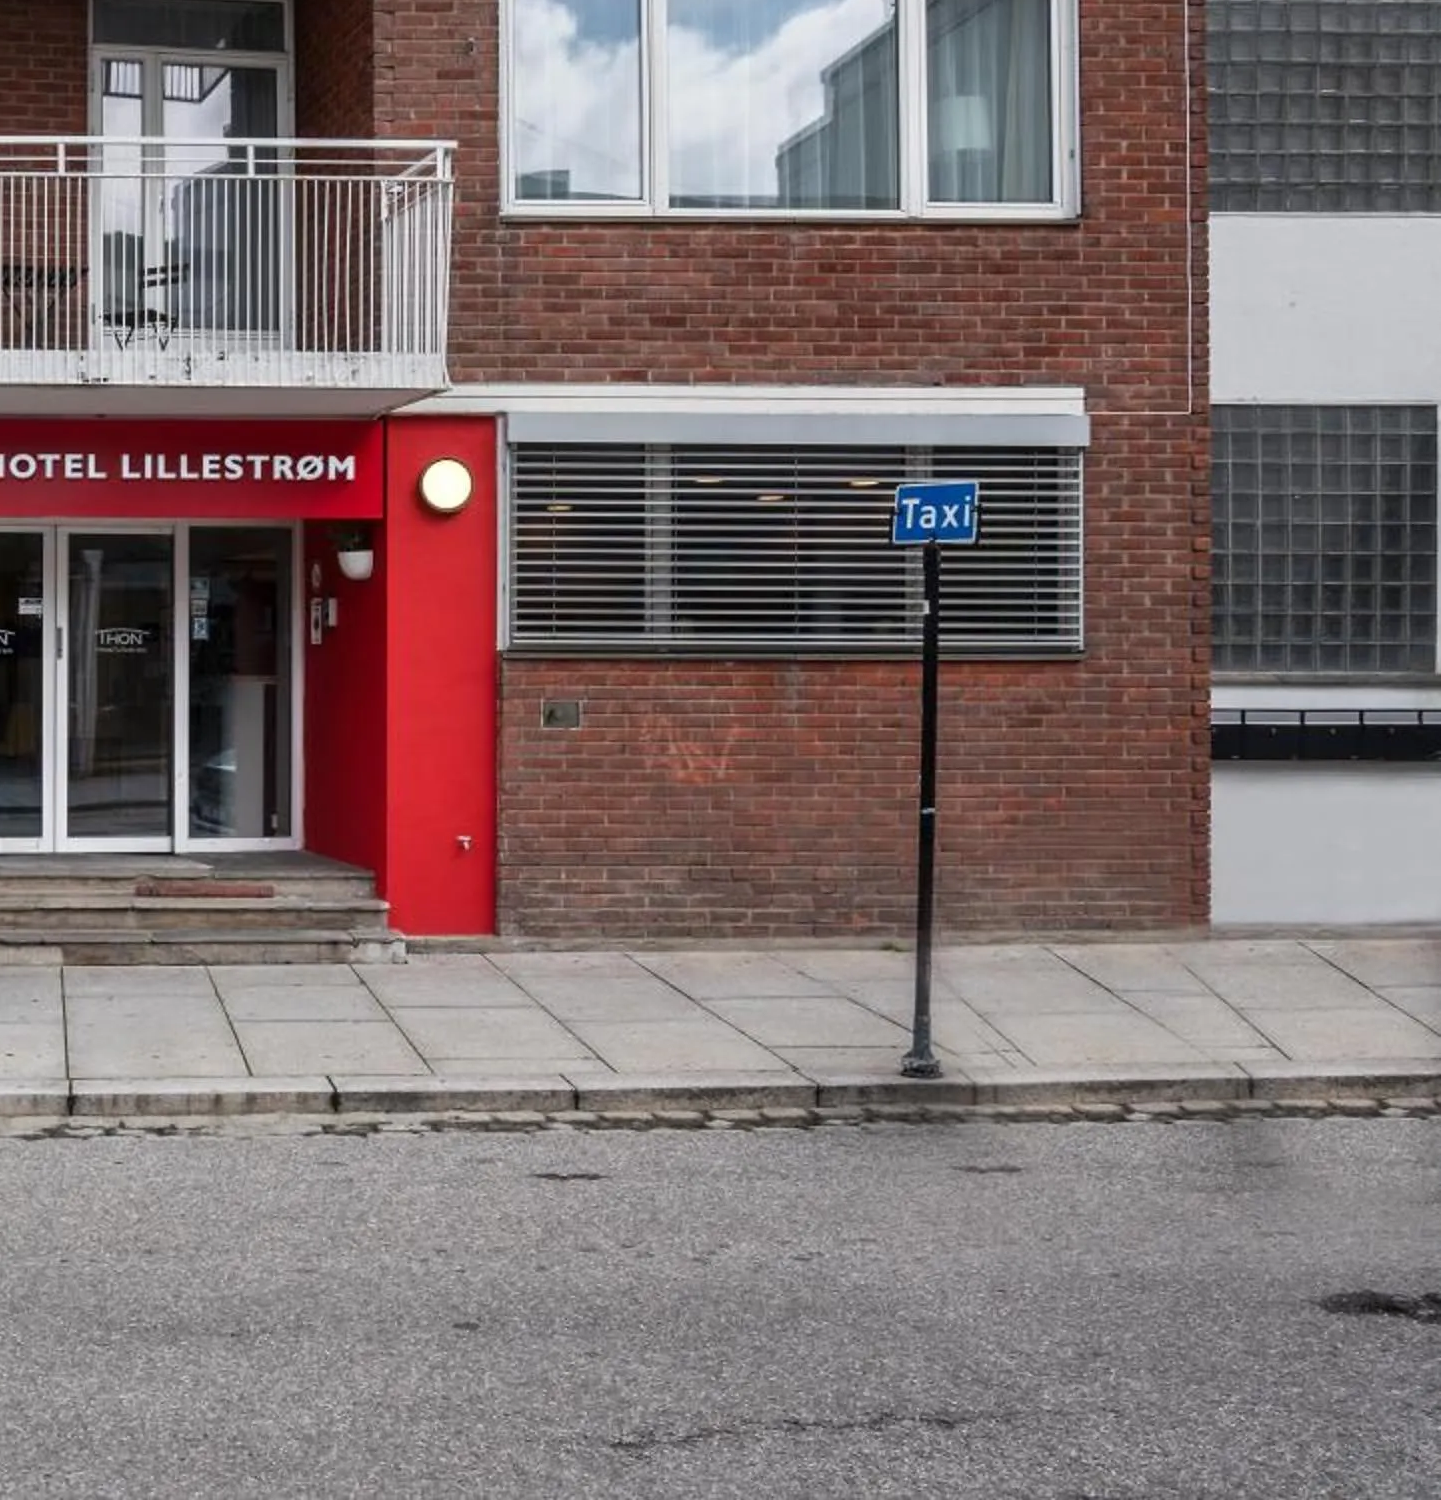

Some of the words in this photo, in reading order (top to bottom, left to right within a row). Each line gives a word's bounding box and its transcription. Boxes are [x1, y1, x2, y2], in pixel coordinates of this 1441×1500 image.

[121, 454, 356, 480] LILLESTRØM
[901, 496, 971, 529] Taxi
[97, 629, 146, 645] THON
